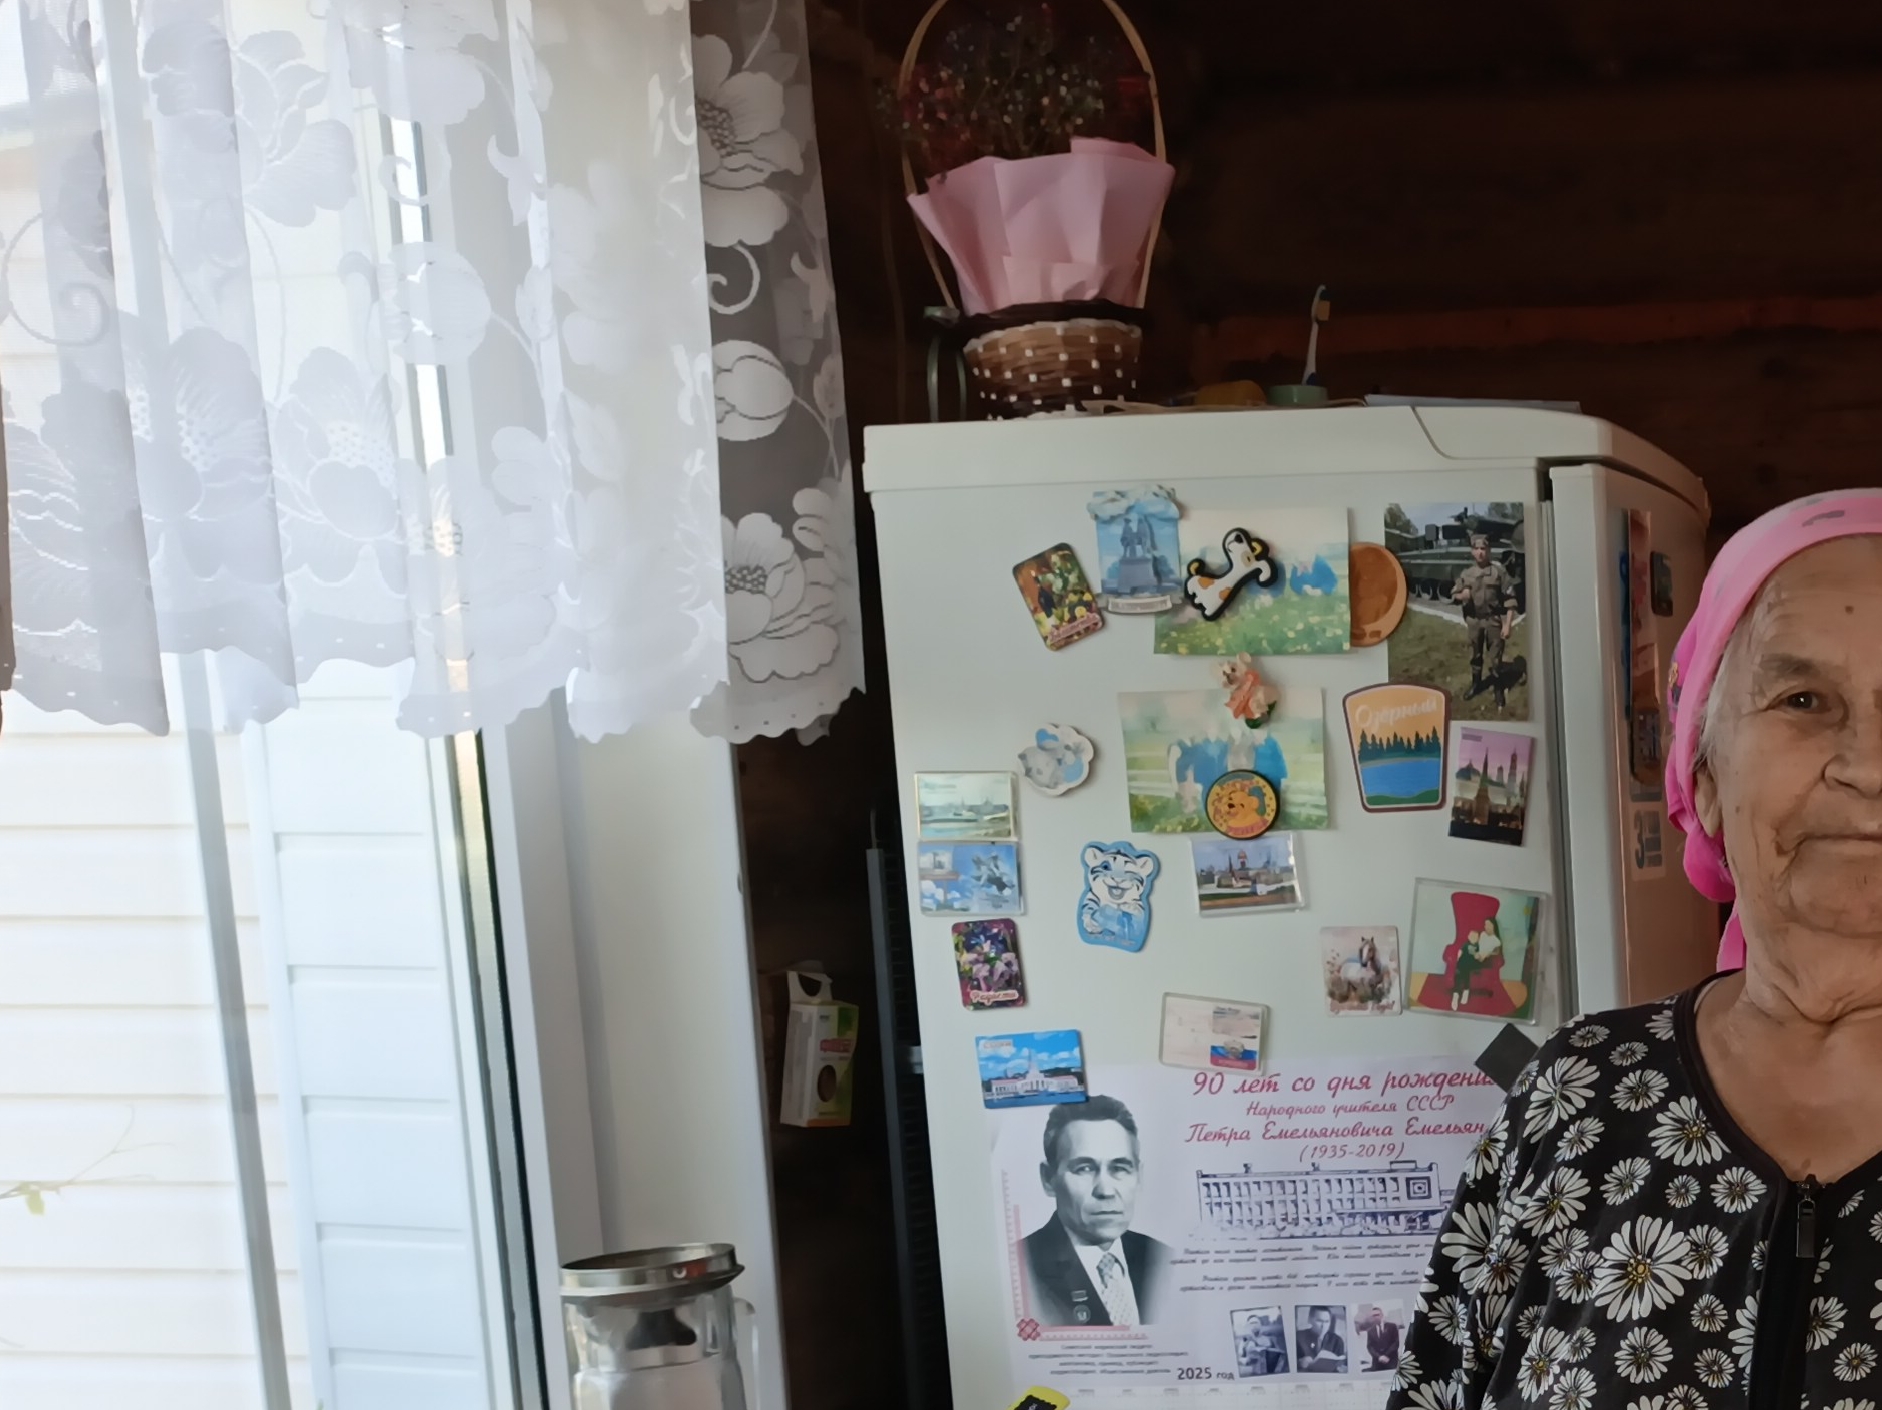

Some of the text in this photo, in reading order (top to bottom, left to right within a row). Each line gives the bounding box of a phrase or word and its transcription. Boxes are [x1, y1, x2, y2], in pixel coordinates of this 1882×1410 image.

[1193, 1071, 1225, 1096] 90
[1233, 1073, 1281, 1093] лет
[1291, 1076, 1316, 1092] со
[1327, 1074, 1371, 1098] дня
[1246, 1094, 1454, 1119] Народного учителя СССР
[1185, 1116, 1485, 1147] Петра Емельяновича Емельян
[1299, 1141, 1405, 1163] (1935-2019)
[1177, 1367, 1213, 1380] 2025
[1216, 1371, 1235, 1381] год
